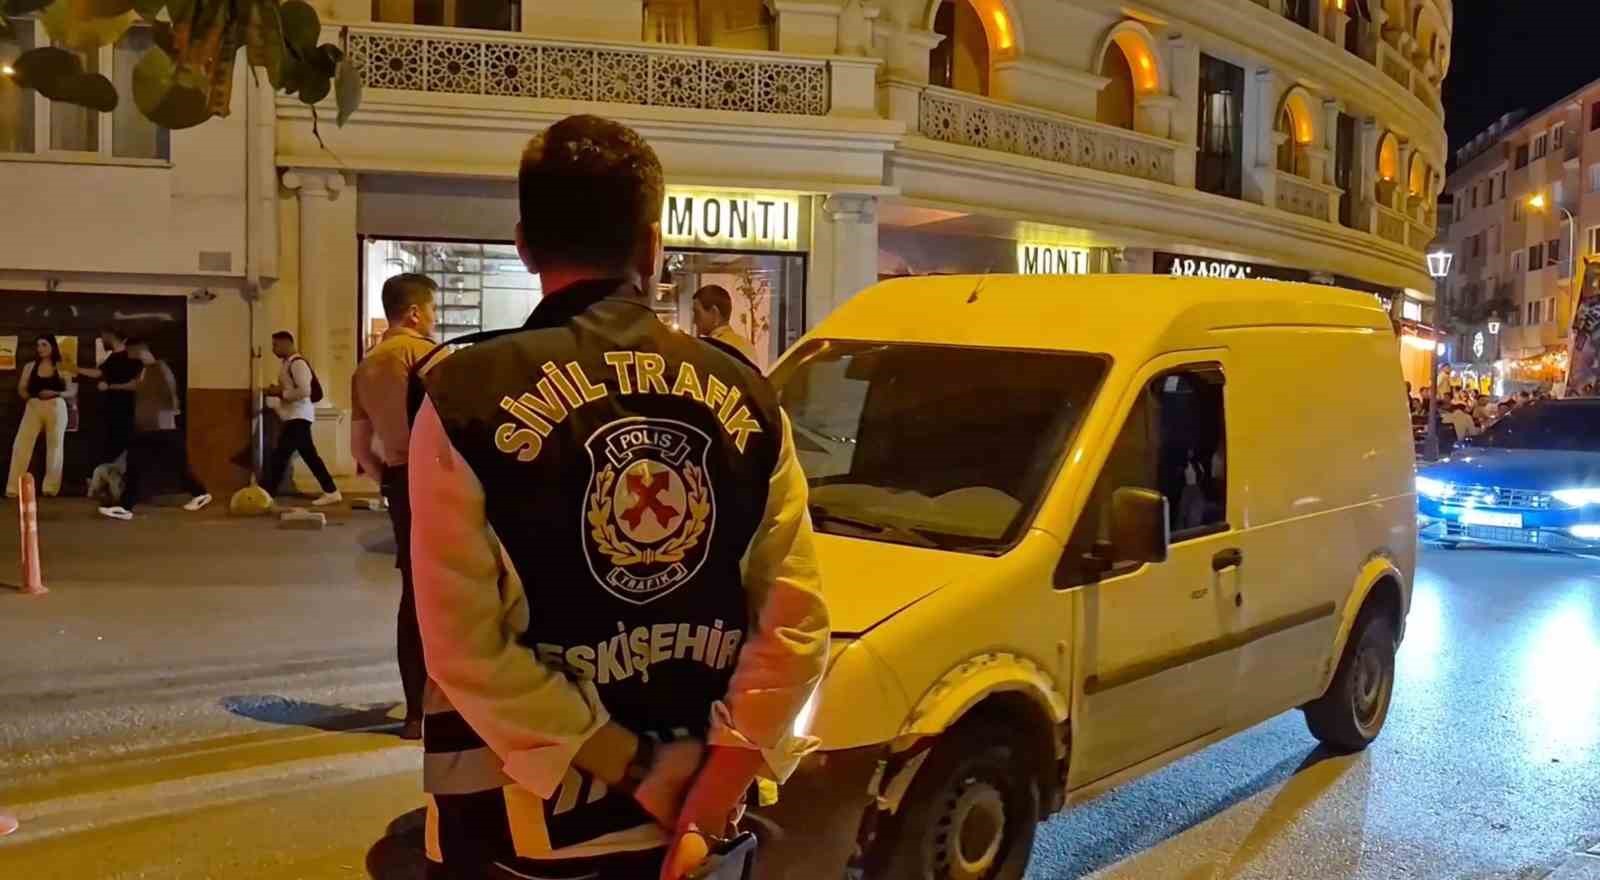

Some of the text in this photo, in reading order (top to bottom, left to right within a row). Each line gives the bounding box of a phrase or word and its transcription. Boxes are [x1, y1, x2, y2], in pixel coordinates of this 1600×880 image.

[668, 196, 789, 240] MONTI
[494, 351, 763, 462] SİVİL TRAFİK
